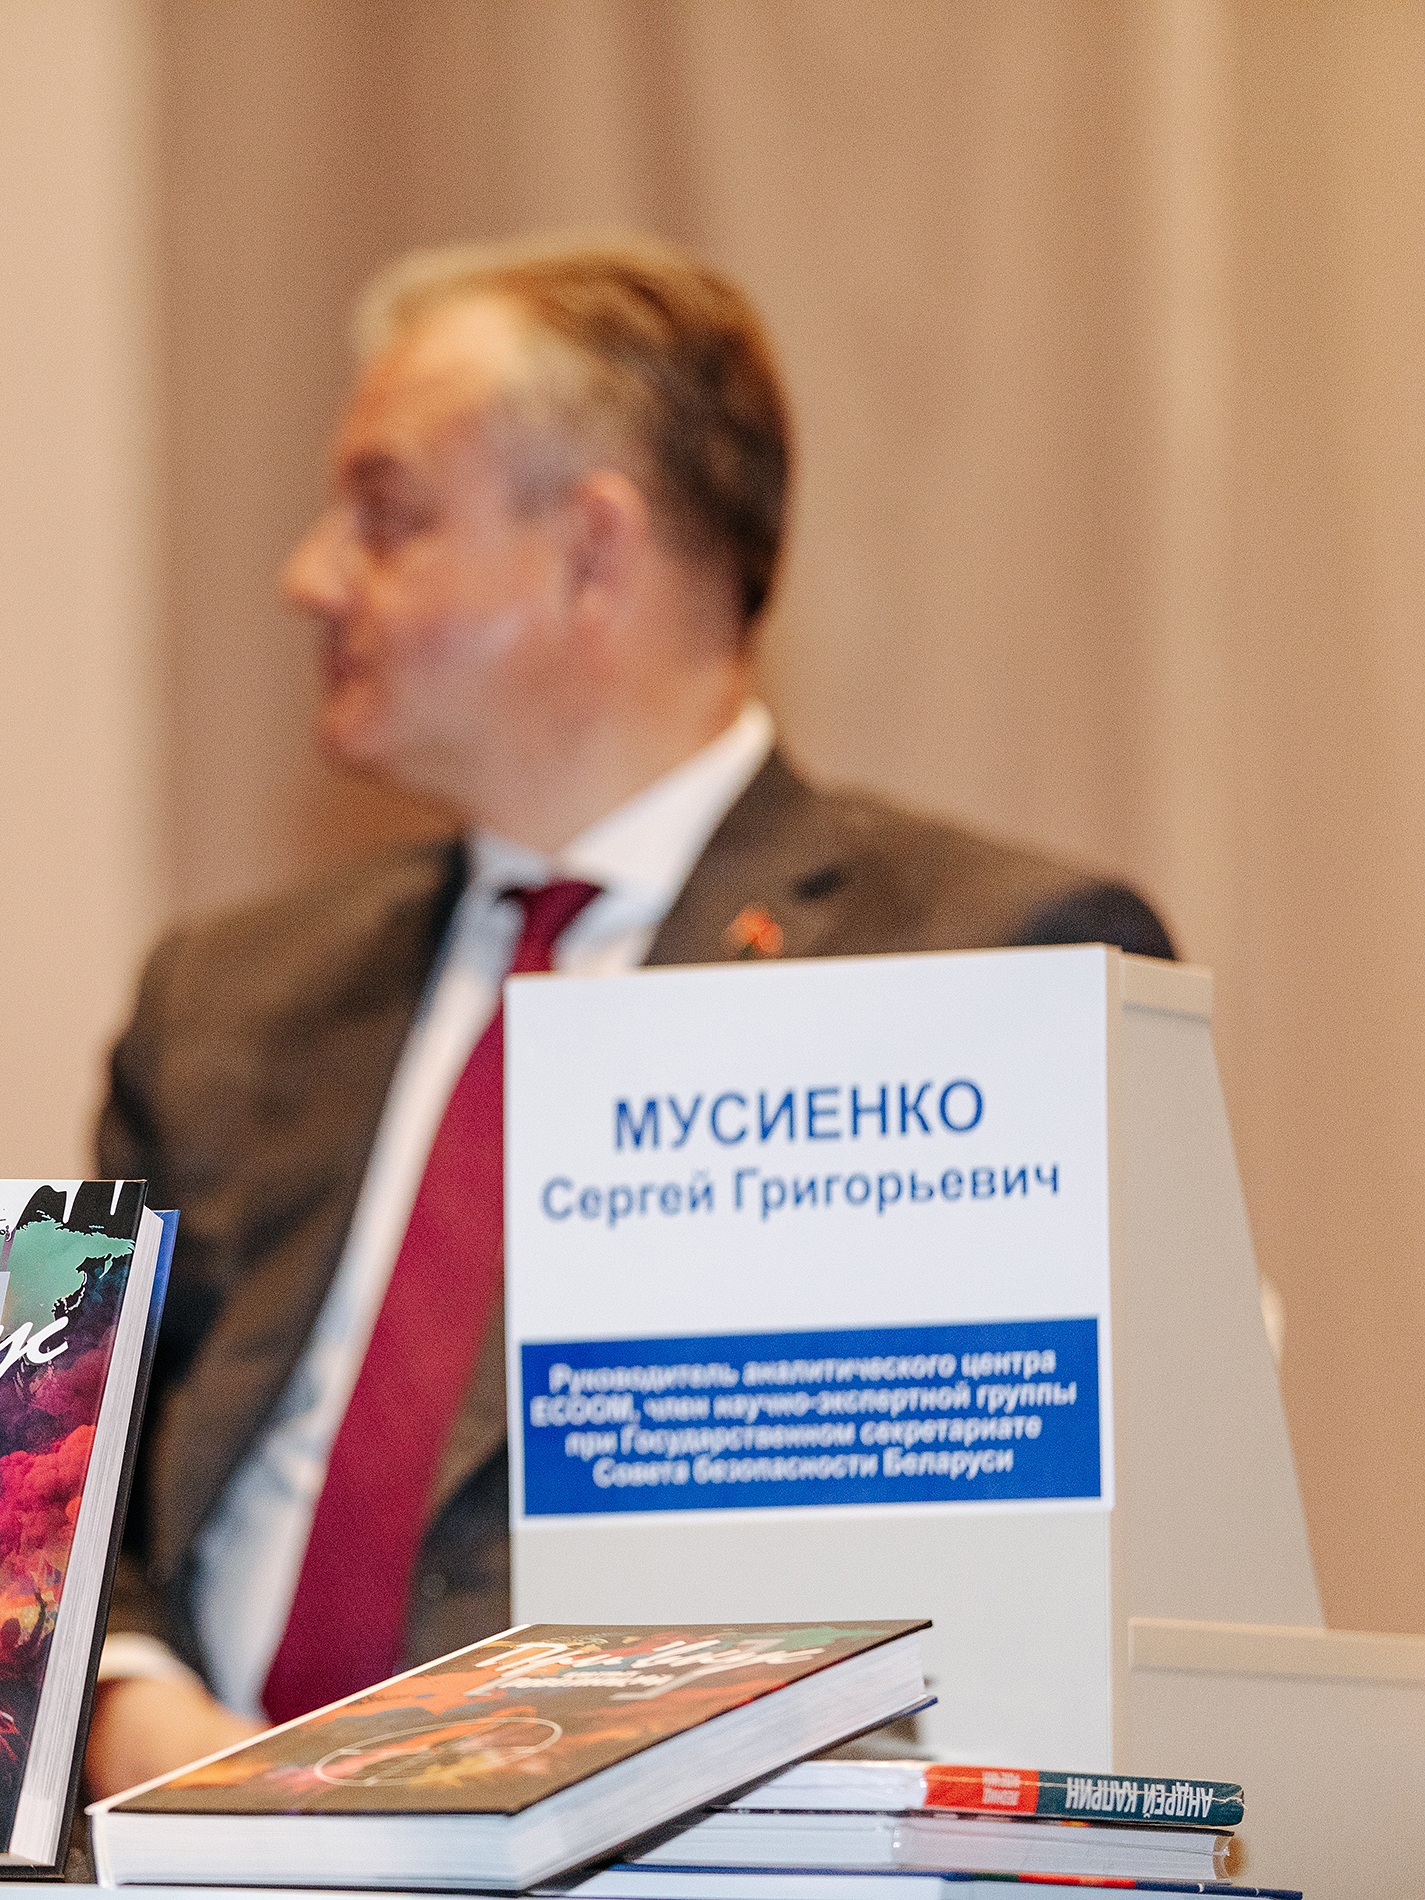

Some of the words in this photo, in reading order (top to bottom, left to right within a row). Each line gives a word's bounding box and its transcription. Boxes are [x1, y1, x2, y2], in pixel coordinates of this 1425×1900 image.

[612, 1077, 986, 1152] МУСИЕНКО
[540, 1170, 715, 1228] Сергей
[732, 1162, 1061, 1220] Григорьевич
[742, 1354, 957, 1387] аналитического
[961, 1349, 1056, 1380] центра
[977, 1382, 1076, 1415] группы
[860, 1415, 1042, 1450] секретариате
[883, 1447, 1013, 1480] Беларуси
[1066, 1777, 1138, 1813] КАПРИН
[1143, 1782, 1213, 1818] АНДРЕЙ
